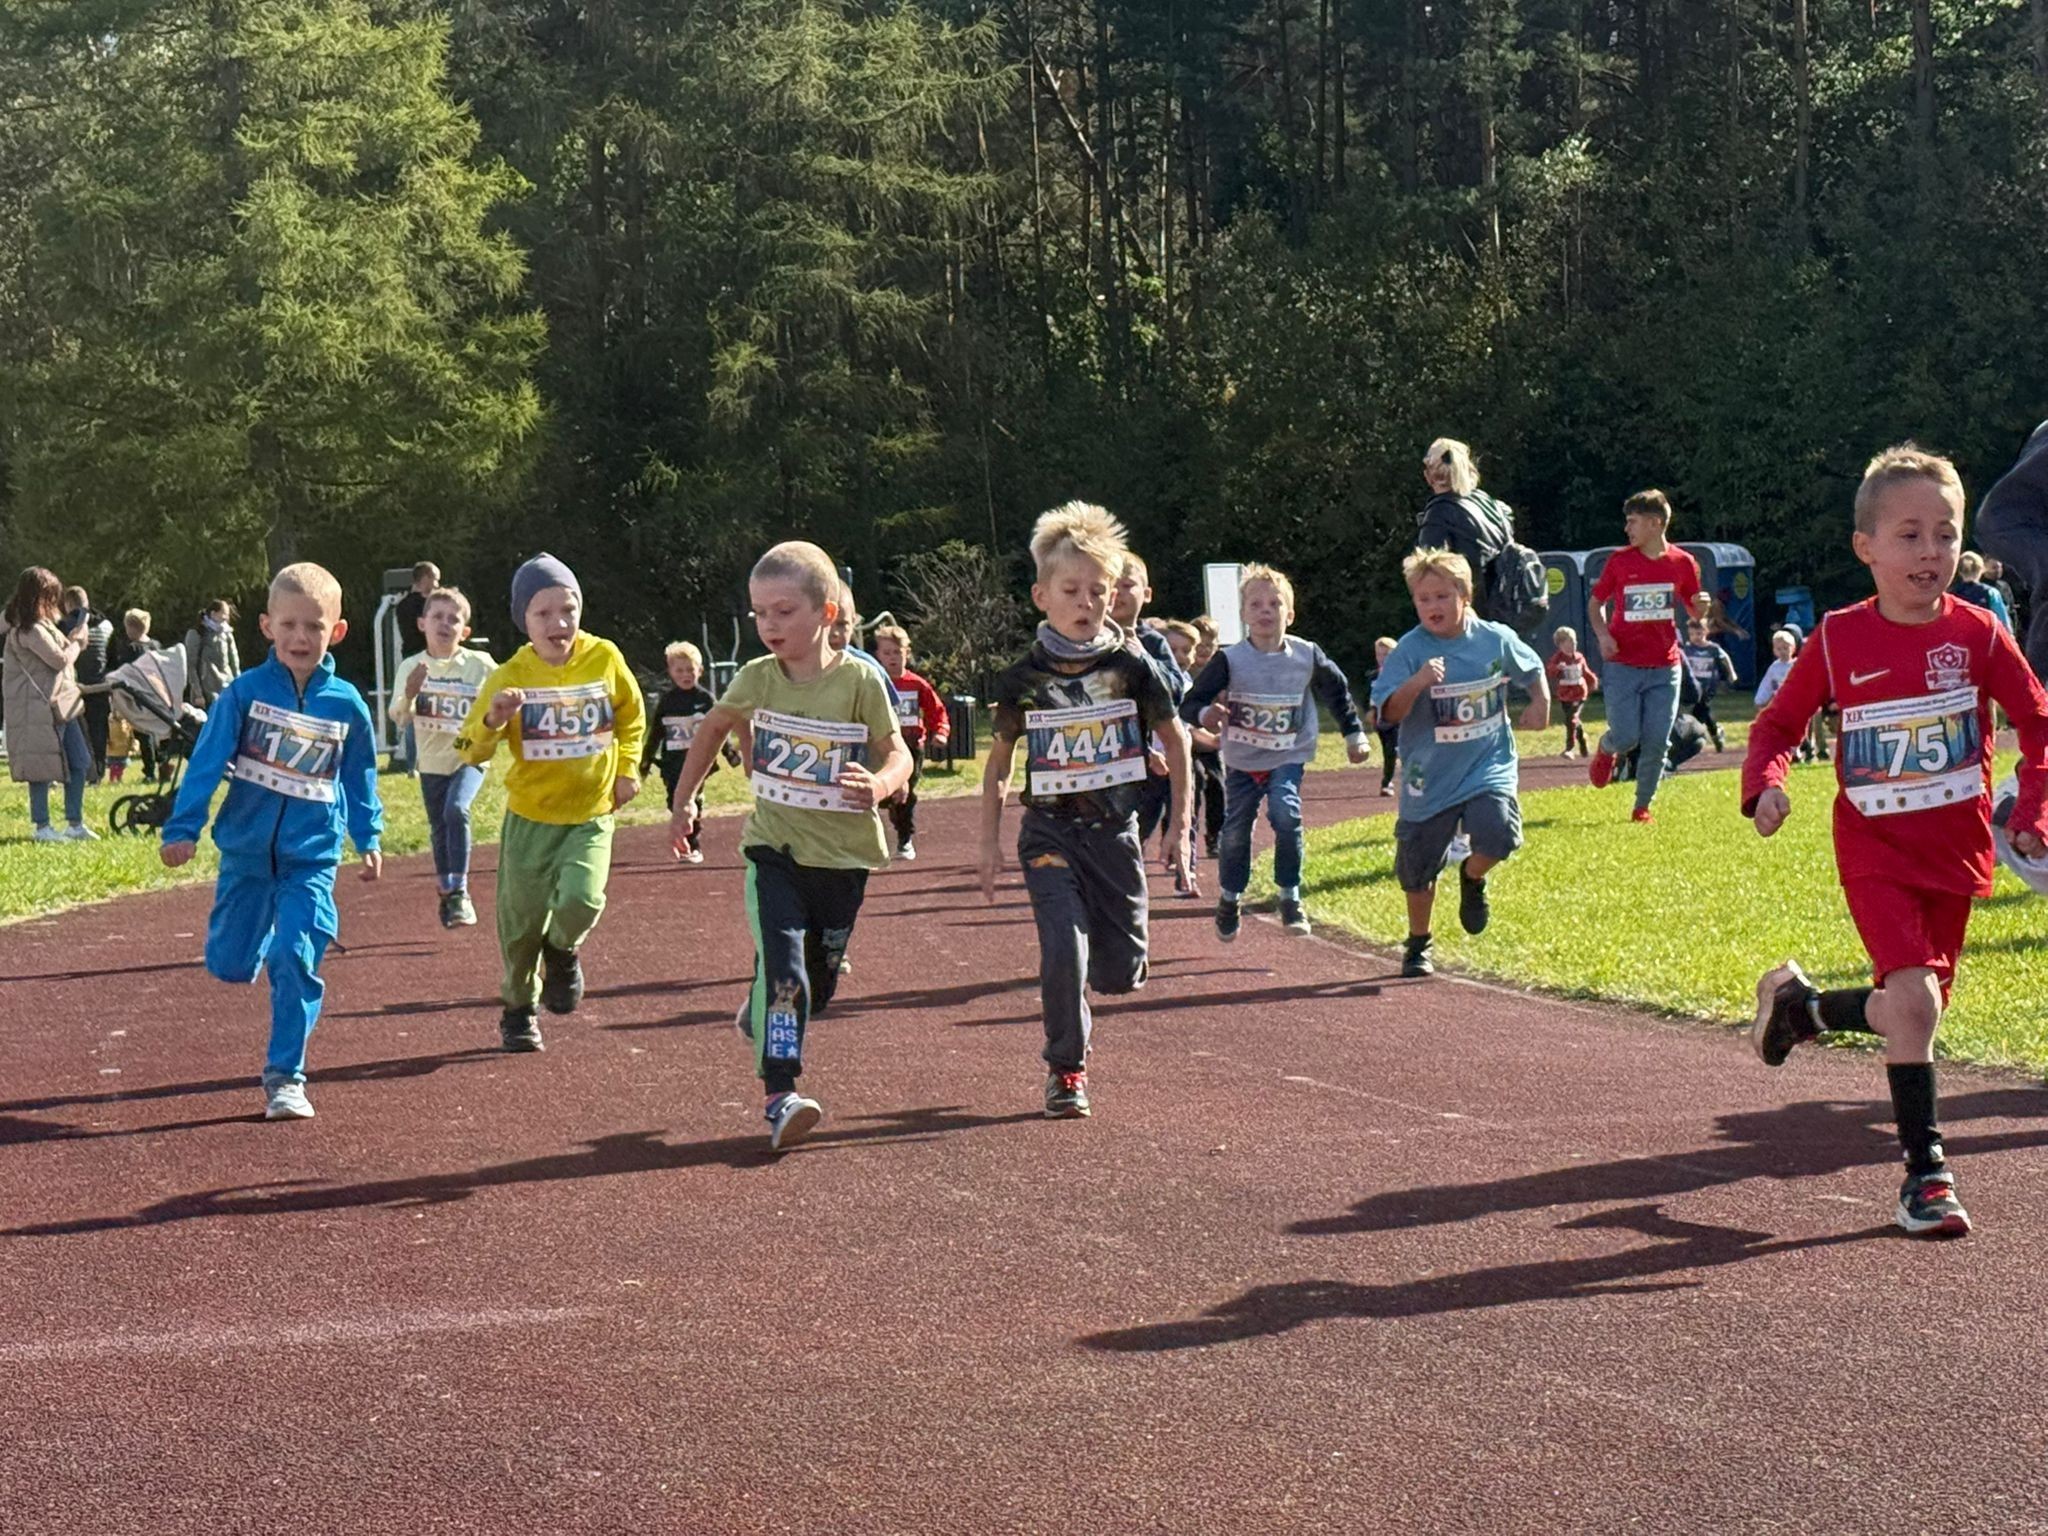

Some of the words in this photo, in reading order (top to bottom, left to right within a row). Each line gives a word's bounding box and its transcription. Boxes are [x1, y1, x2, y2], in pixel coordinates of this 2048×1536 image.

[427, 694, 471, 719] 150
[537, 703, 600, 736] 459
[1240, 706, 1290, 733] 325
[1457, 694, 1488, 722] 61
[1845, 709, 1864, 724] XIX
[265, 731, 334, 775] 177
[766, 737, 842, 784] 221
[1046, 723, 1122, 767] 444
[1878, 723, 1949, 778] 75
